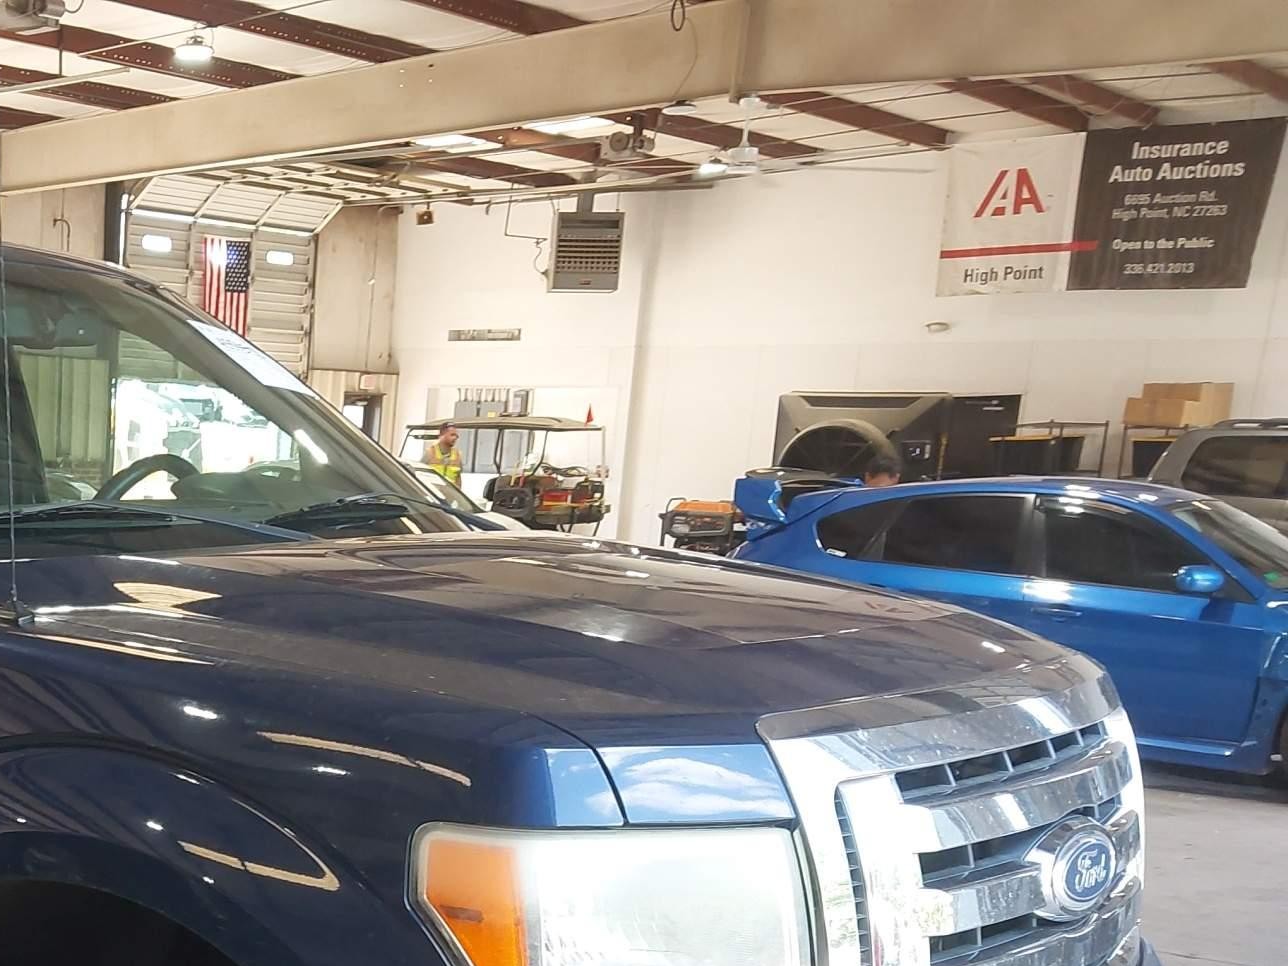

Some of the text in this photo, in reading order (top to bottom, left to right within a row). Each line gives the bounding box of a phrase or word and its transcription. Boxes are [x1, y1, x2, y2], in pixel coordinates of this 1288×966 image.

[1132, 139, 1229, 160] Insurance
[1108, 161, 1246, 183] Auto Auctions
[1152, 192, 1197, 204] Auction
[1112, 208, 1138, 221] High
[1172, 206, 1191, 217] NC
[1112, 237, 1215, 252] Open to the Public
[964, 264, 1044, 286] High Point
[1075, 849, 1107, 892] Ford
